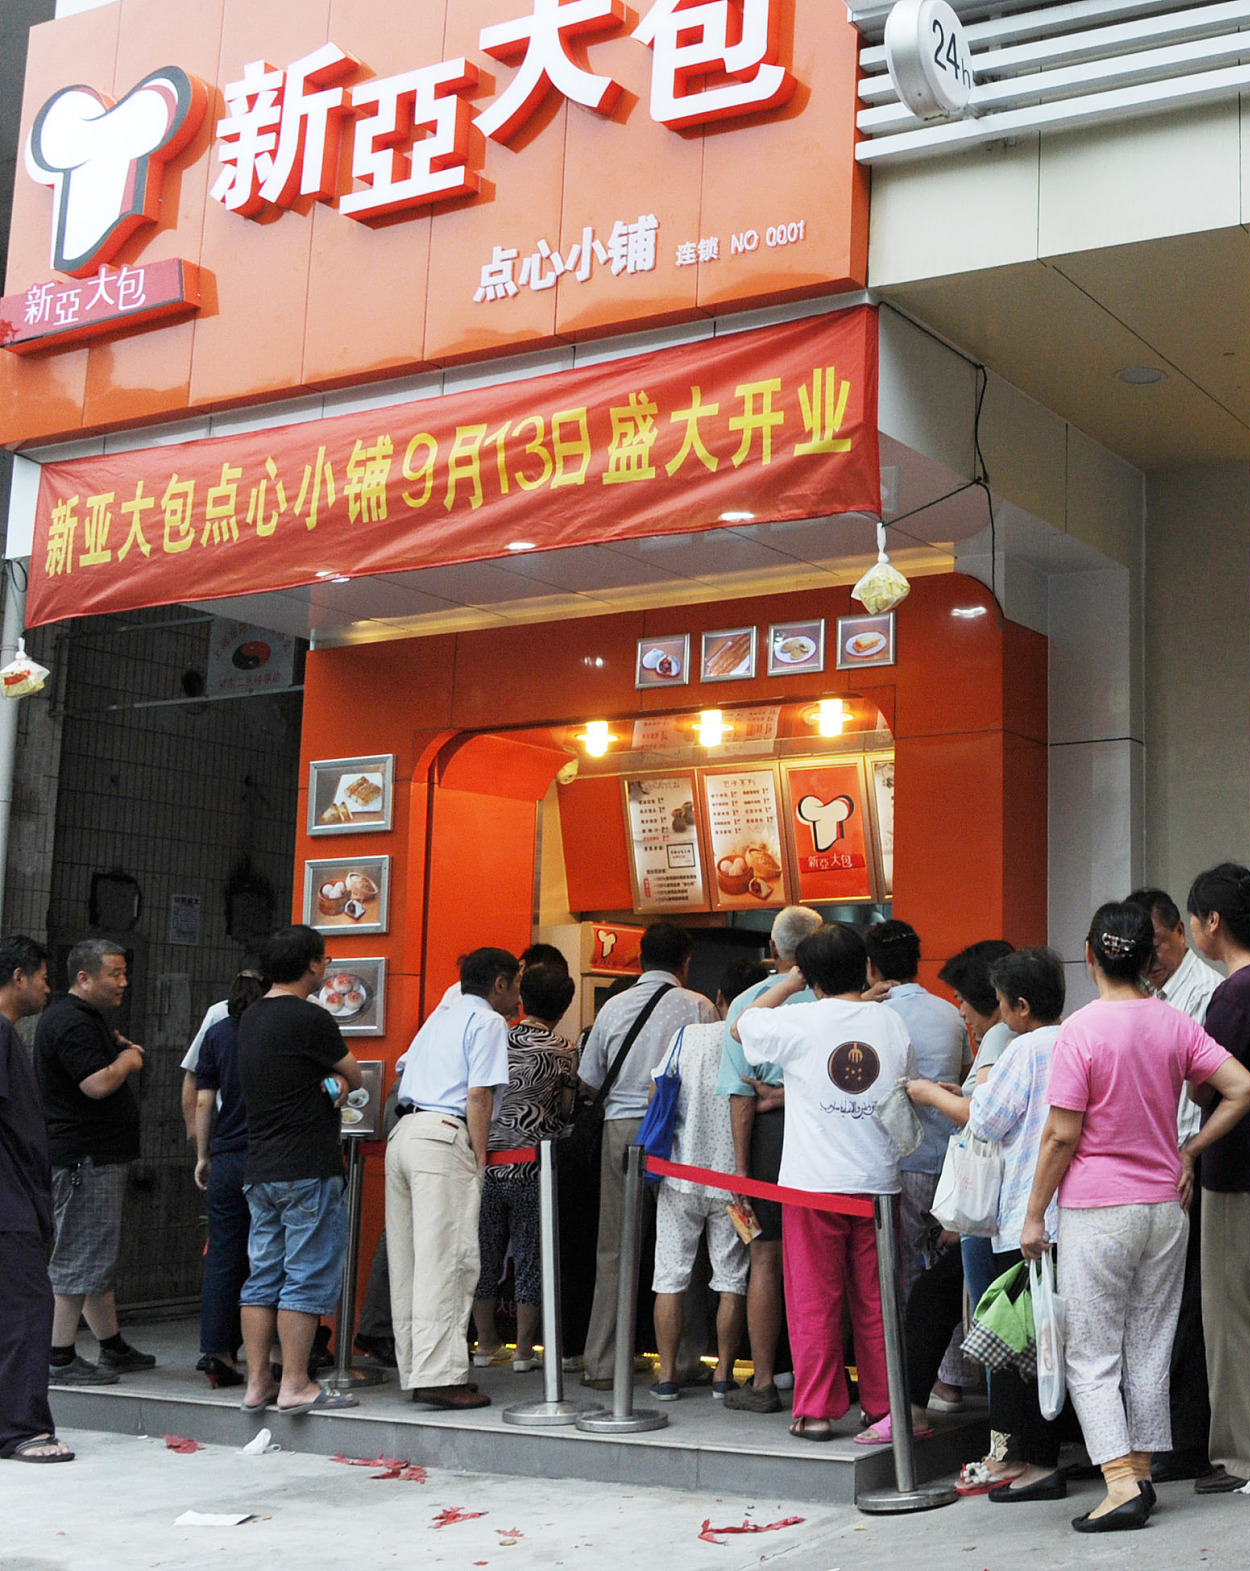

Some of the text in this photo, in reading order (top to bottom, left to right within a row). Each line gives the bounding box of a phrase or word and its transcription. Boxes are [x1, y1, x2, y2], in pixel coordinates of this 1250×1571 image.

[931, 19, 972, 91] 24h
[209, 0, 787, 218] 新亞大包
[24, 266, 147, 326] 新亞大包
[472, 213, 807, 304] 点心小铺 连锁 NO 0001
